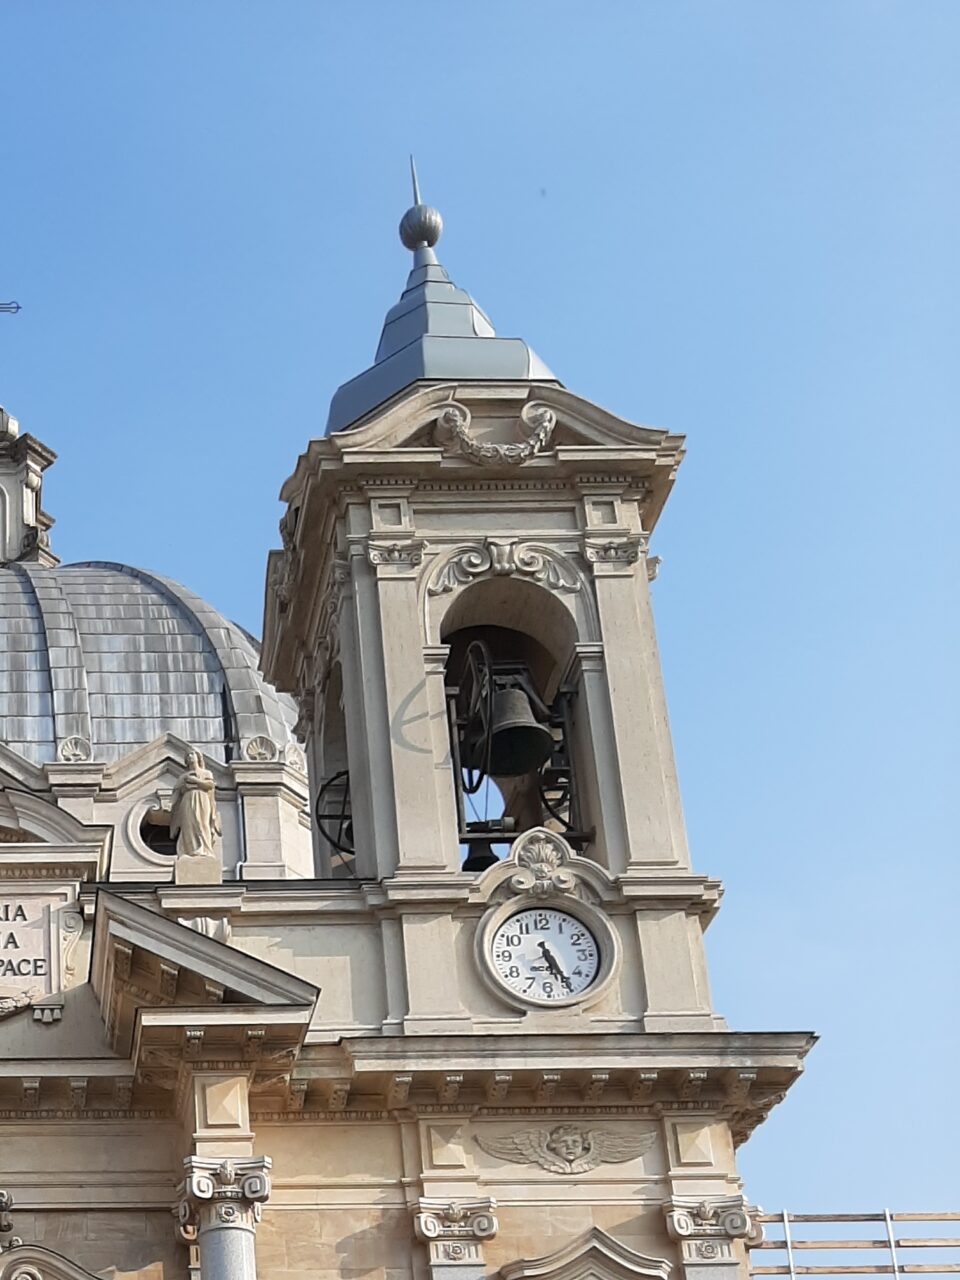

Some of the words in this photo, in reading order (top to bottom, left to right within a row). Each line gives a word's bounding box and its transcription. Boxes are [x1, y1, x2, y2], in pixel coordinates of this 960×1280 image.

[519, 923, 530, 935] 11
[534, 918, 550, 930] 12
[558, 922, 563, 934] 1
[505, 934, 521, 947] 10
[570, 933, 581, 946] 2
[502, 950, 512, 962] 9
[576, 949, 588, 962] 3
[509, 966, 520, 978] 8
[572, 965, 583, 978] 4
[525, 977, 536, 989] 7
[542, 981, 553, 994] 6
